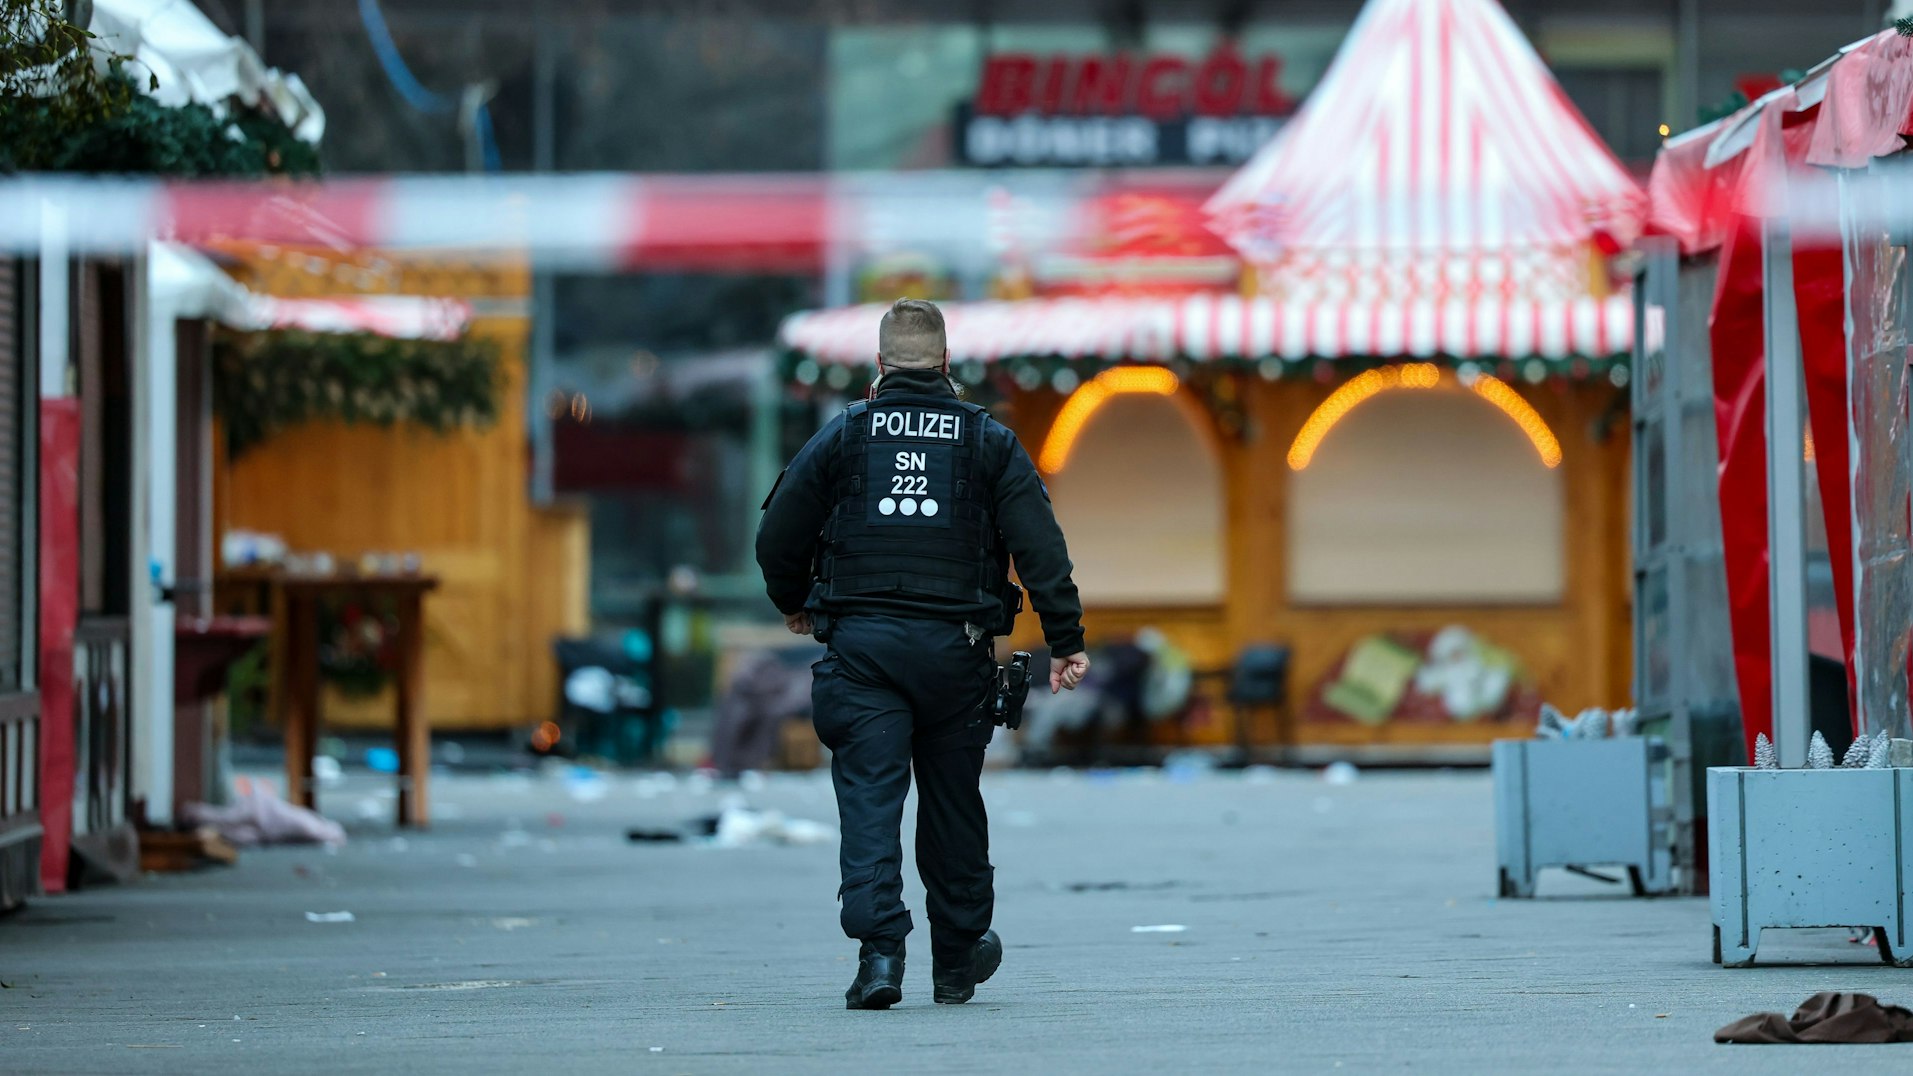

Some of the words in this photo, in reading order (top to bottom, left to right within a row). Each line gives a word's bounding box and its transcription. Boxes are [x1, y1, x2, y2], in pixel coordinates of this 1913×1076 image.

[871, 411, 960, 440] POLIZEI
[895, 451, 926, 471] SN
[890, 475, 928, 495] 222
